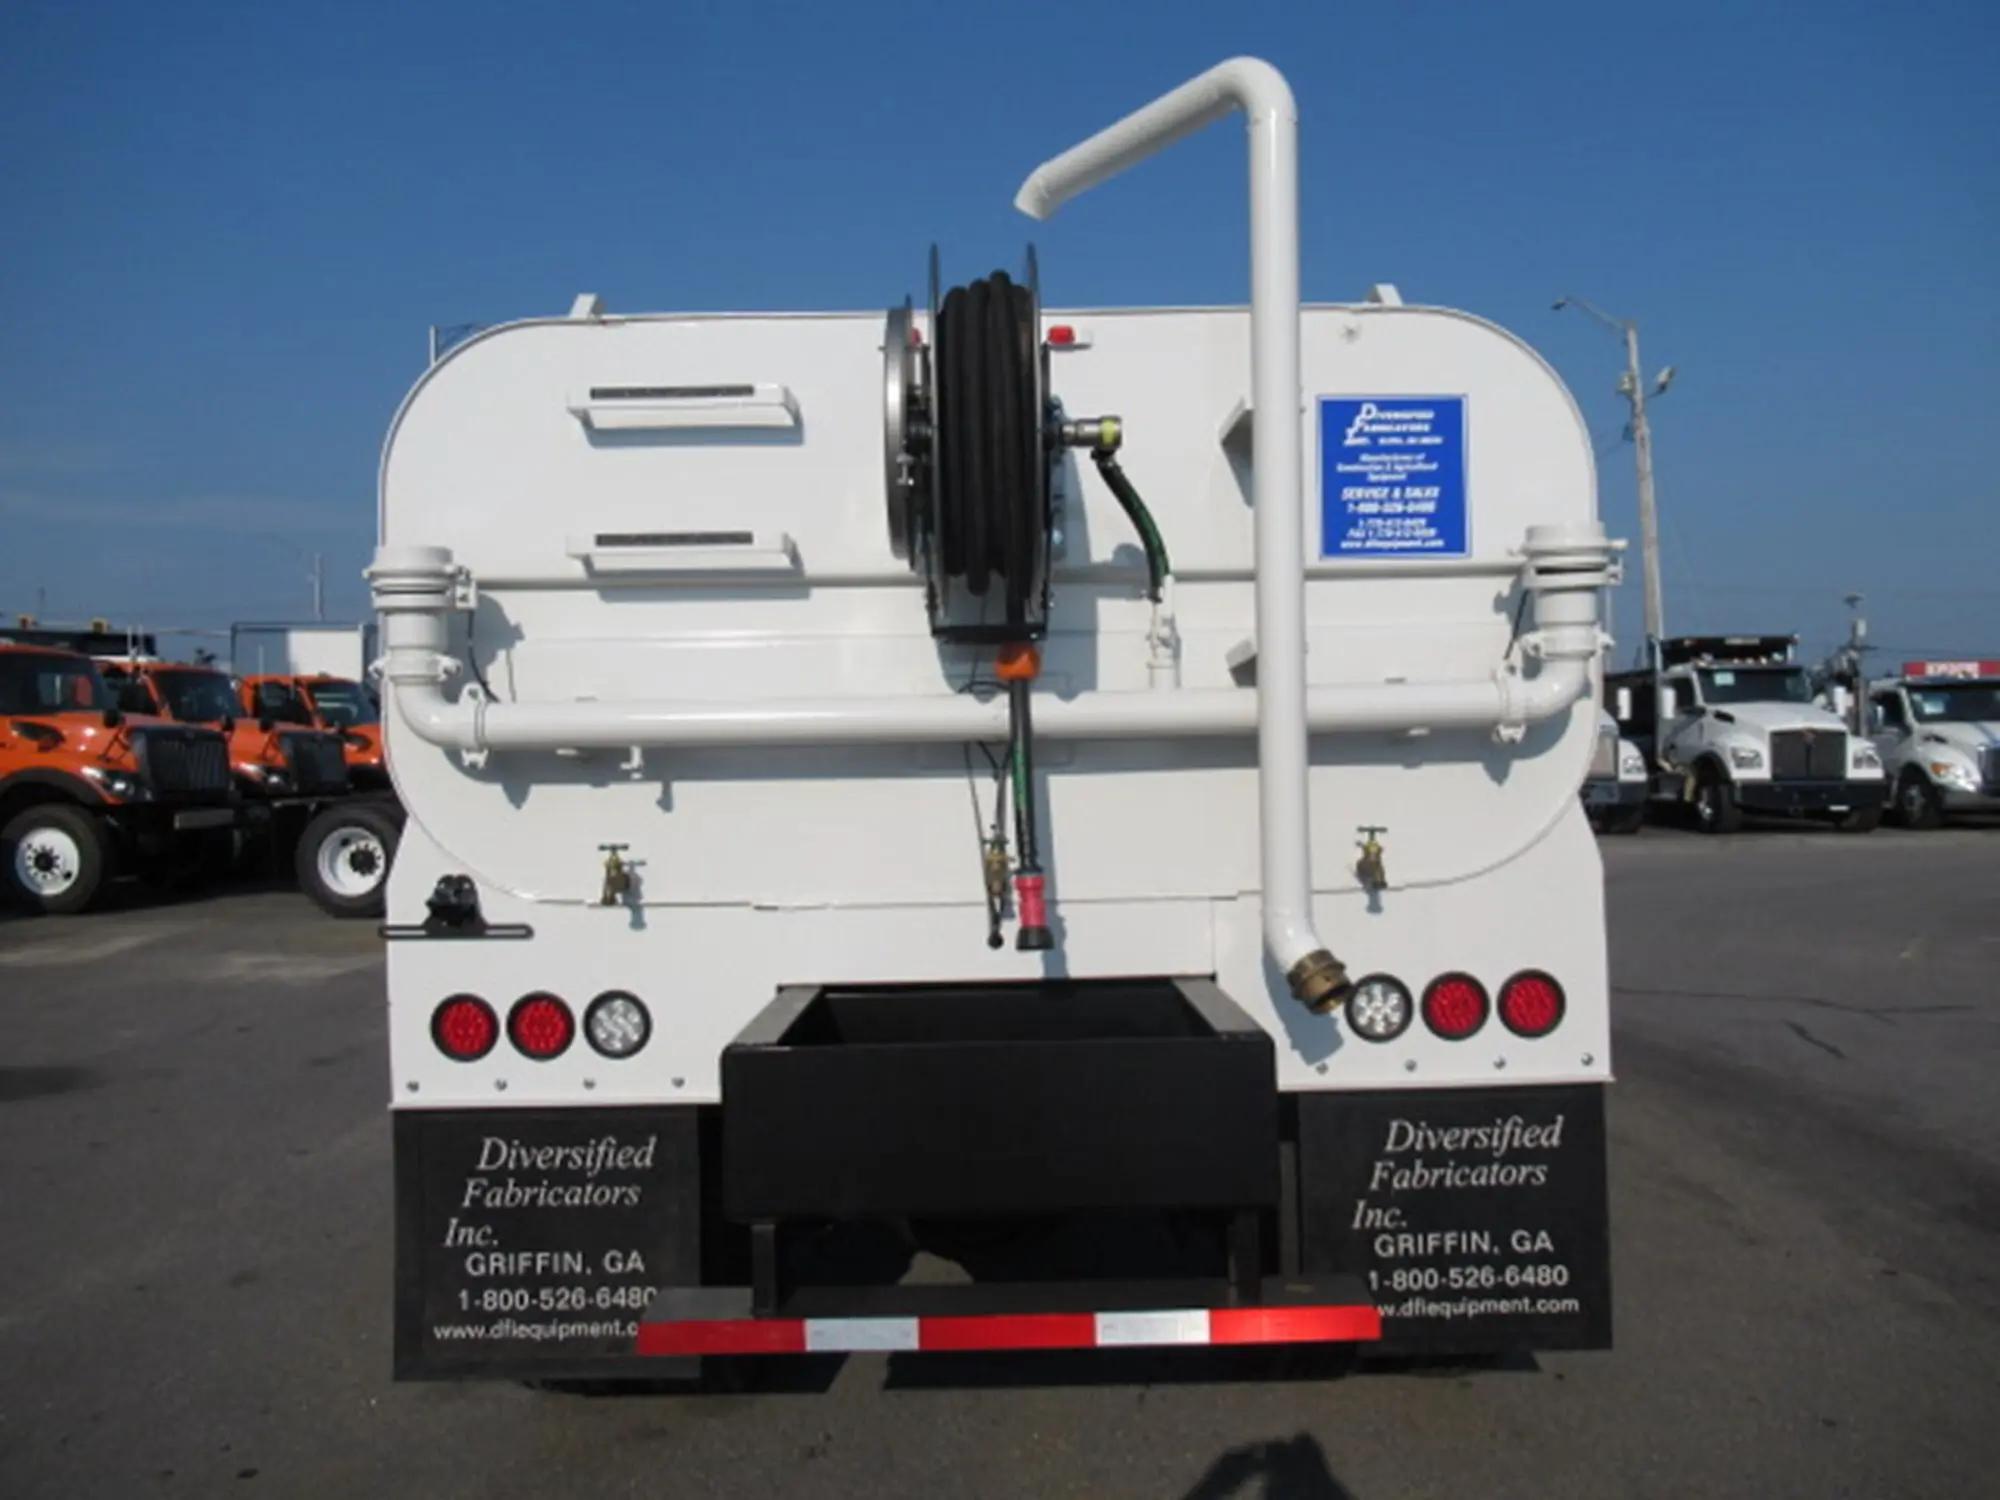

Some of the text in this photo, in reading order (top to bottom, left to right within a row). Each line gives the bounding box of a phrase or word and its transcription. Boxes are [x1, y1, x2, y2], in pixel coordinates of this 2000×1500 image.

[1341, 486, 1390, 501] SERVICE
[1404, 486, 1440, 499] SALES
[1384, 1114, 1565, 1157] Diversified
[476, 1135, 658, 1178] Diversified
[1369, 1159, 1549, 1192] Fabricators
[461, 1177, 642, 1208] Fabricators
[1351, 1200, 1408, 1230] Inc.
[444, 1217, 499, 1247] Inc.
[1511, 1229, 1554, 1253] GA
[603, 1249, 645, 1274] GA
[1368, 1264, 1570, 1291] 1-800-526-6480
[1376, 1296, 1580, 1318] w.dfiequipment.com
[433, 1318, 639, 1341] www.dfiequipment.c
